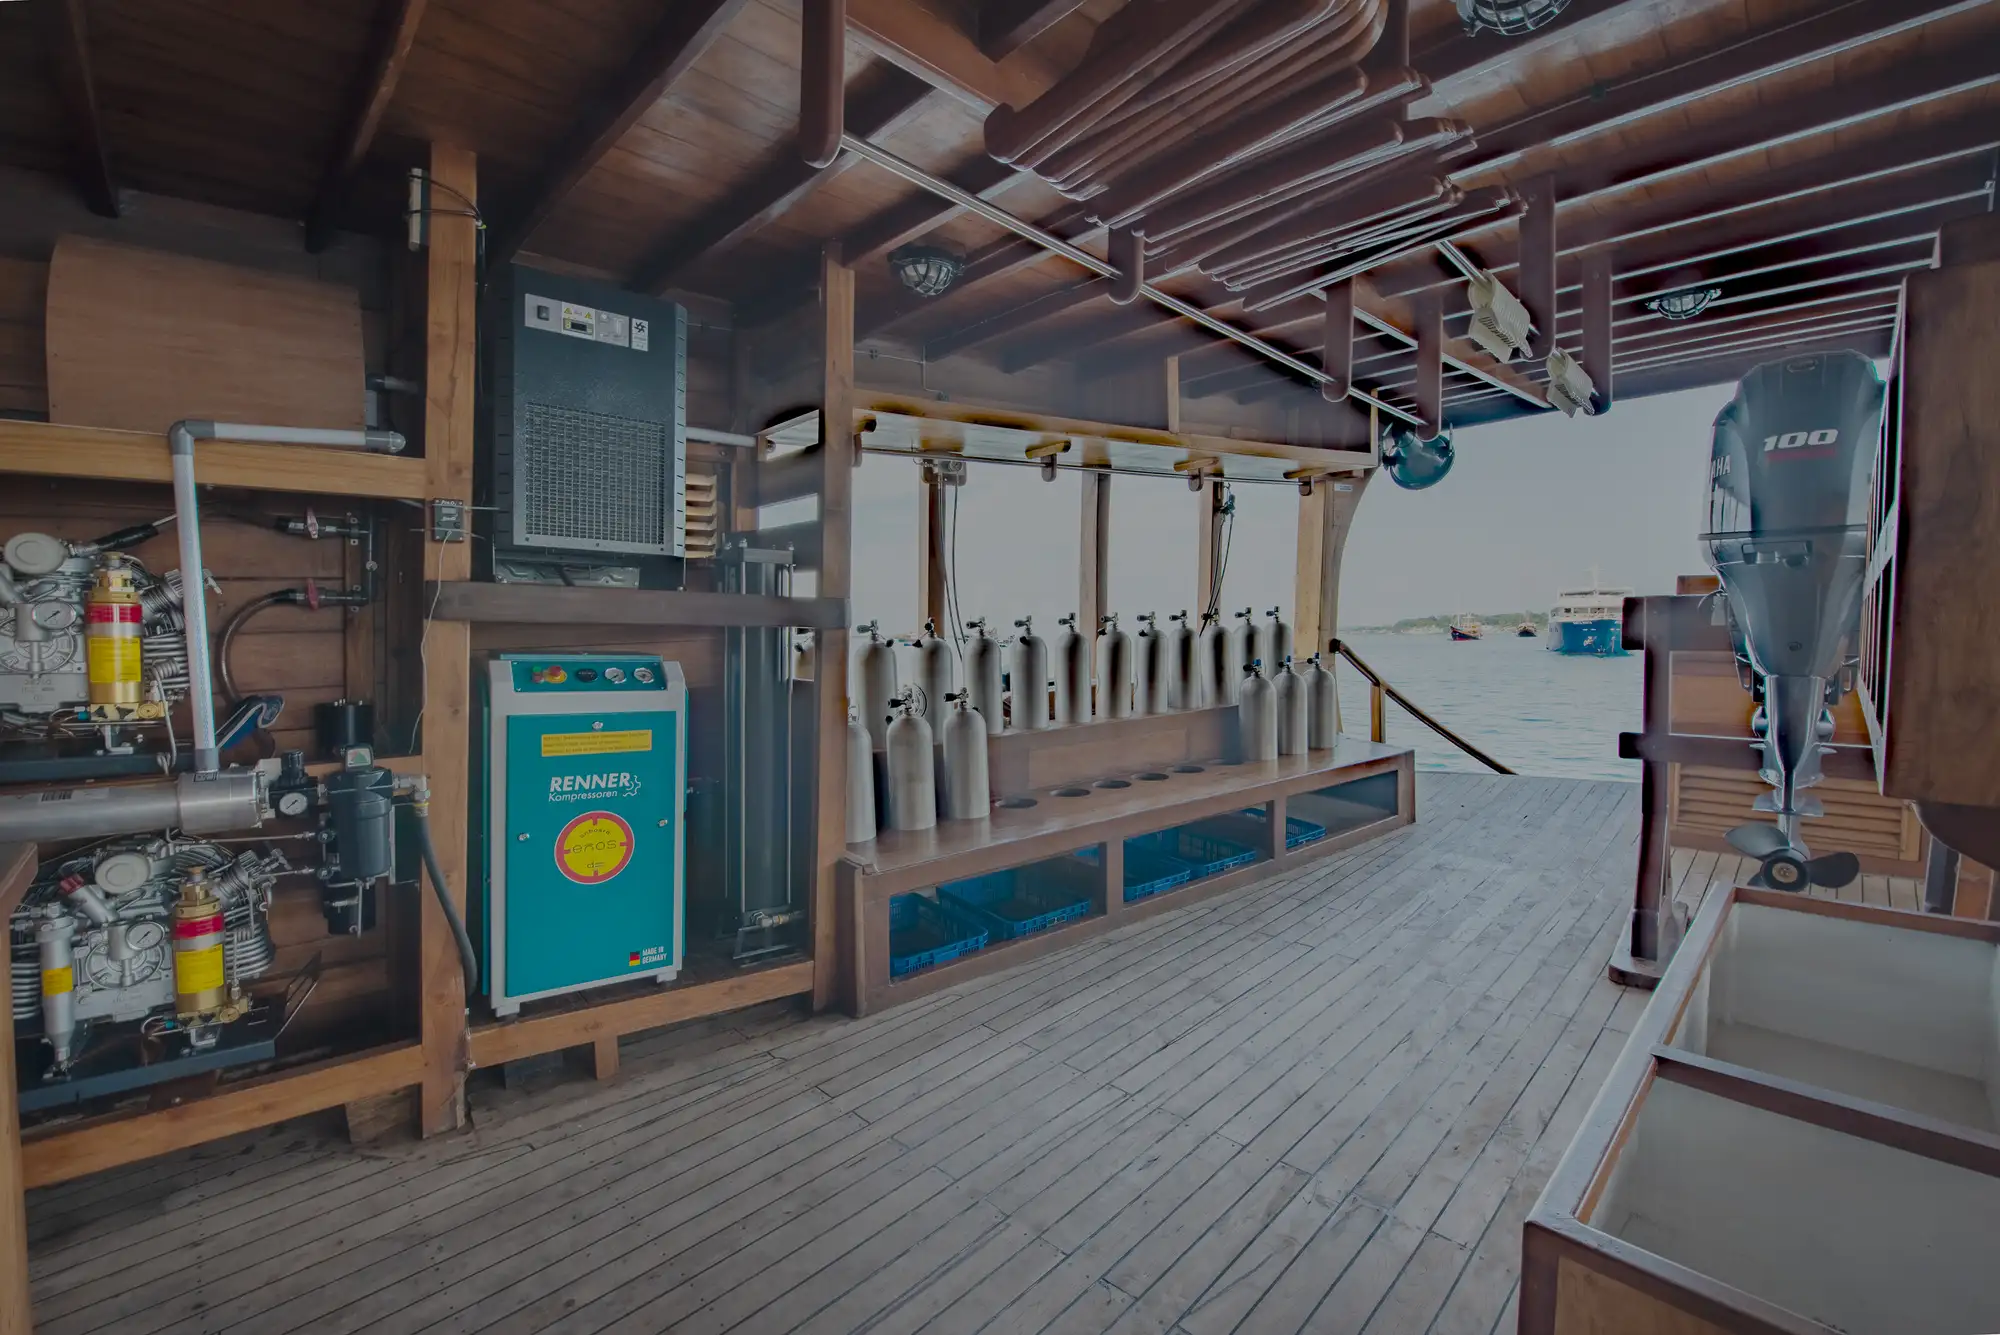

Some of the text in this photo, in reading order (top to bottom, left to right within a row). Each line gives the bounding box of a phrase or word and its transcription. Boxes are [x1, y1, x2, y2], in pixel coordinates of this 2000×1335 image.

[1763, 429, 1839, 451] 100
[549, 772, 631, 793] RENNER
[548, 790, 618, 803] Kompressoren
[642, 947, 657, 957] MADE
[642, 953, 667, 965] GERMANY
